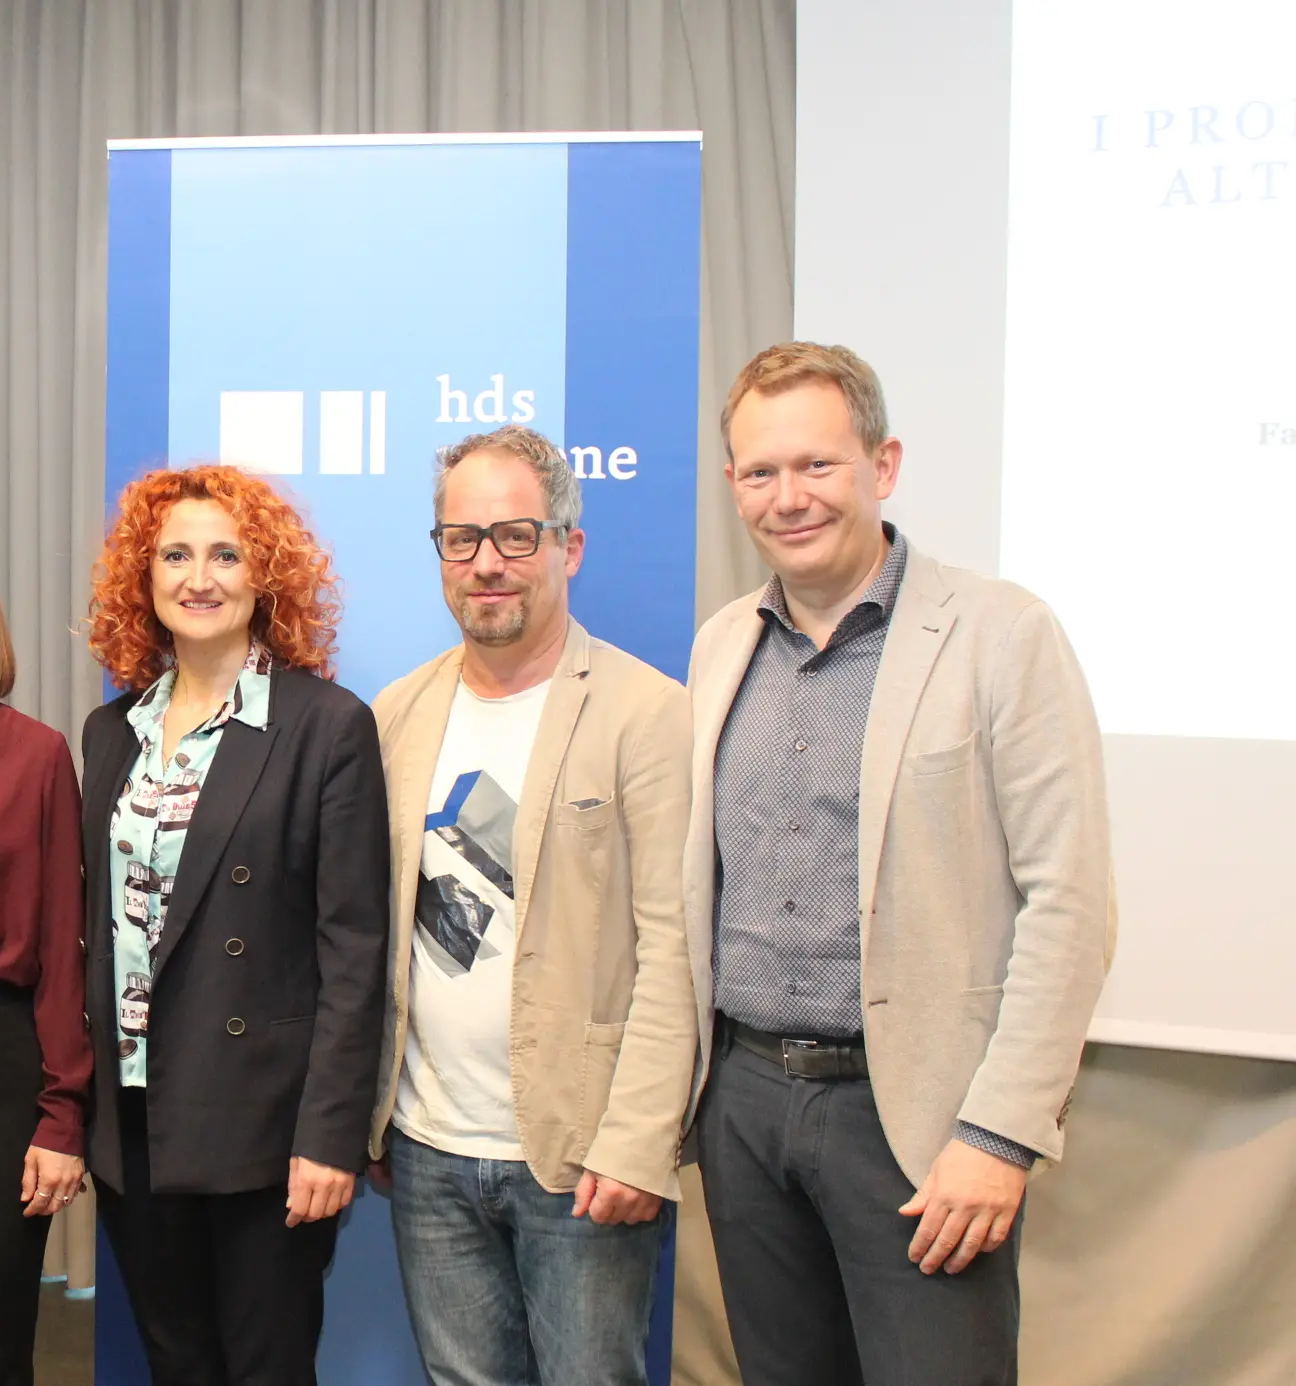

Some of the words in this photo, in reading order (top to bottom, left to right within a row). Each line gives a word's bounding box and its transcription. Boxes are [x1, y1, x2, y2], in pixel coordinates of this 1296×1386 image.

[1092, 114, 1109, 152] I
[1143, 98, 1296, 149] PRO
[1159, 161, 1289, 207] ALT
[435, 373, 536, 423] hds
